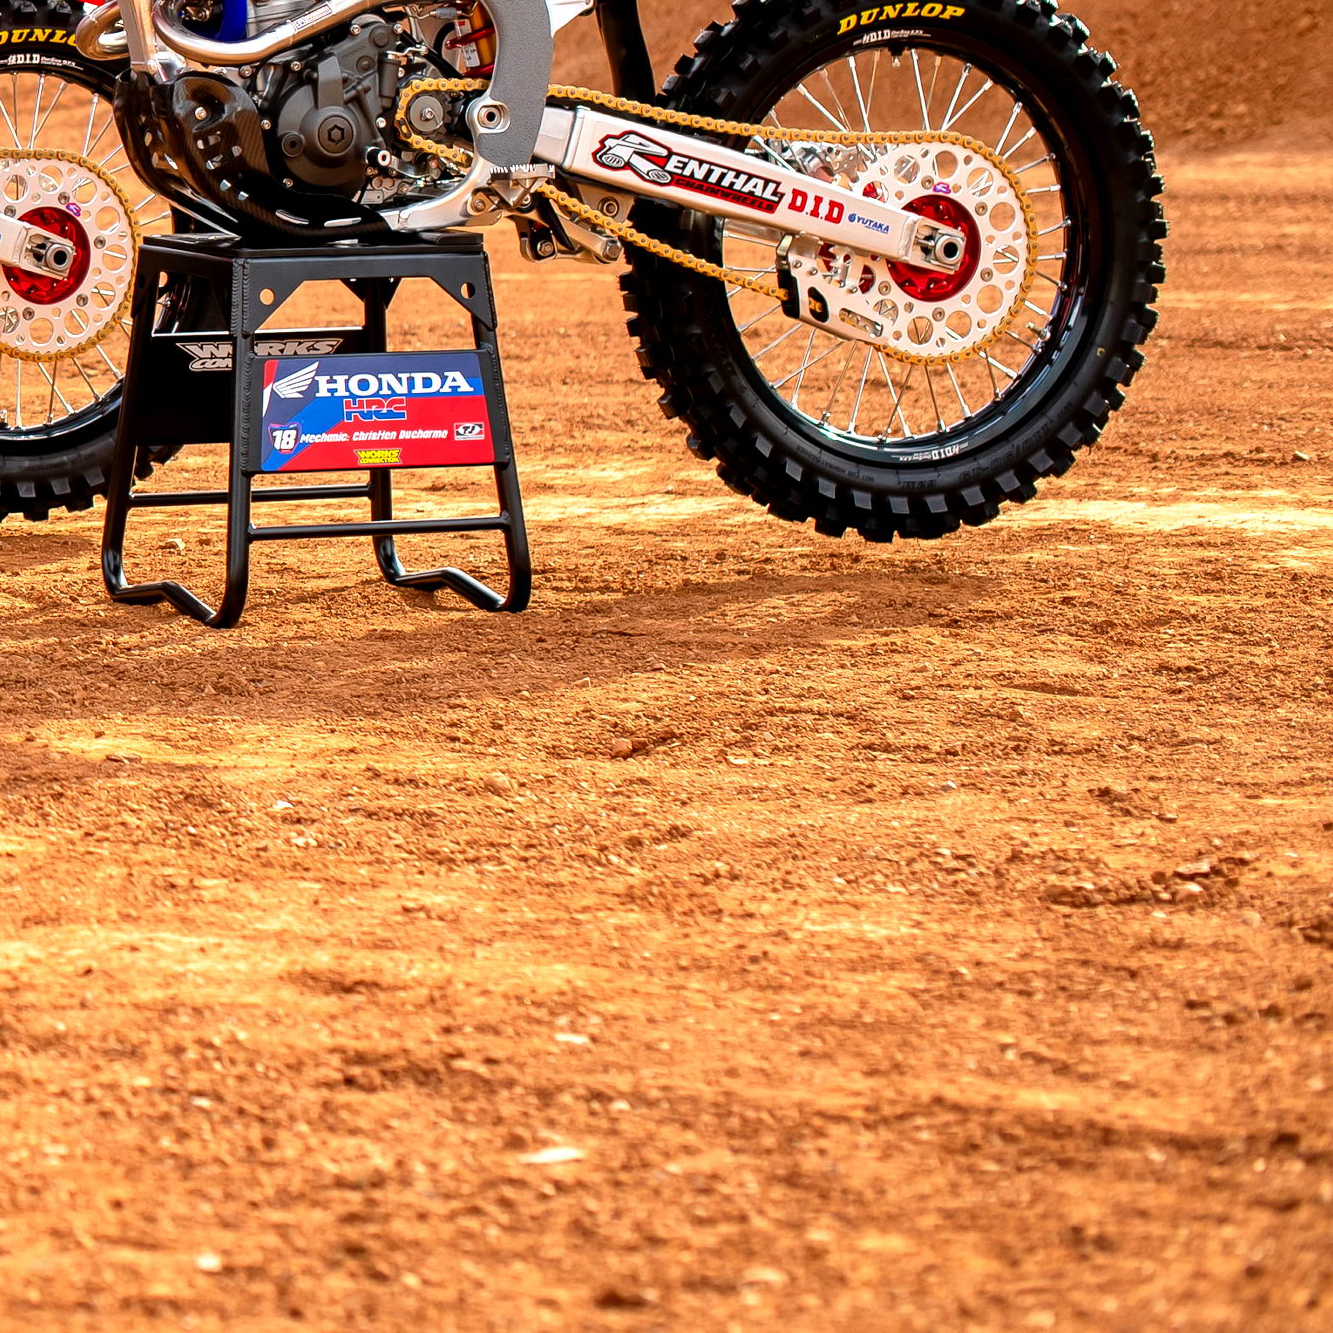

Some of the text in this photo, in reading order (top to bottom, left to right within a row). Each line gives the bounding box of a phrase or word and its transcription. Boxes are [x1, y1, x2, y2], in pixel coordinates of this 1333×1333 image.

[836, 2, 966, 35] DUNLOP
[593, 131, 783, 203] RENTHAL
[673, 177, 776, 213] CHAINWHEELS
[788, 188, 846, 225] D.I.D
[856, 215, 891, 233] YUTAKA
[179, 339, 337, 356] WRKS
[314, 371, 474, 397] HONDA
[343, 396, 407, 423] HRC
[271, 428, 298, 453] 18
[299, 432, 350, 444] Mechanic:
[398, 428, 449, 440] Ducharme
[356, 449, 400, 459] WORKS
